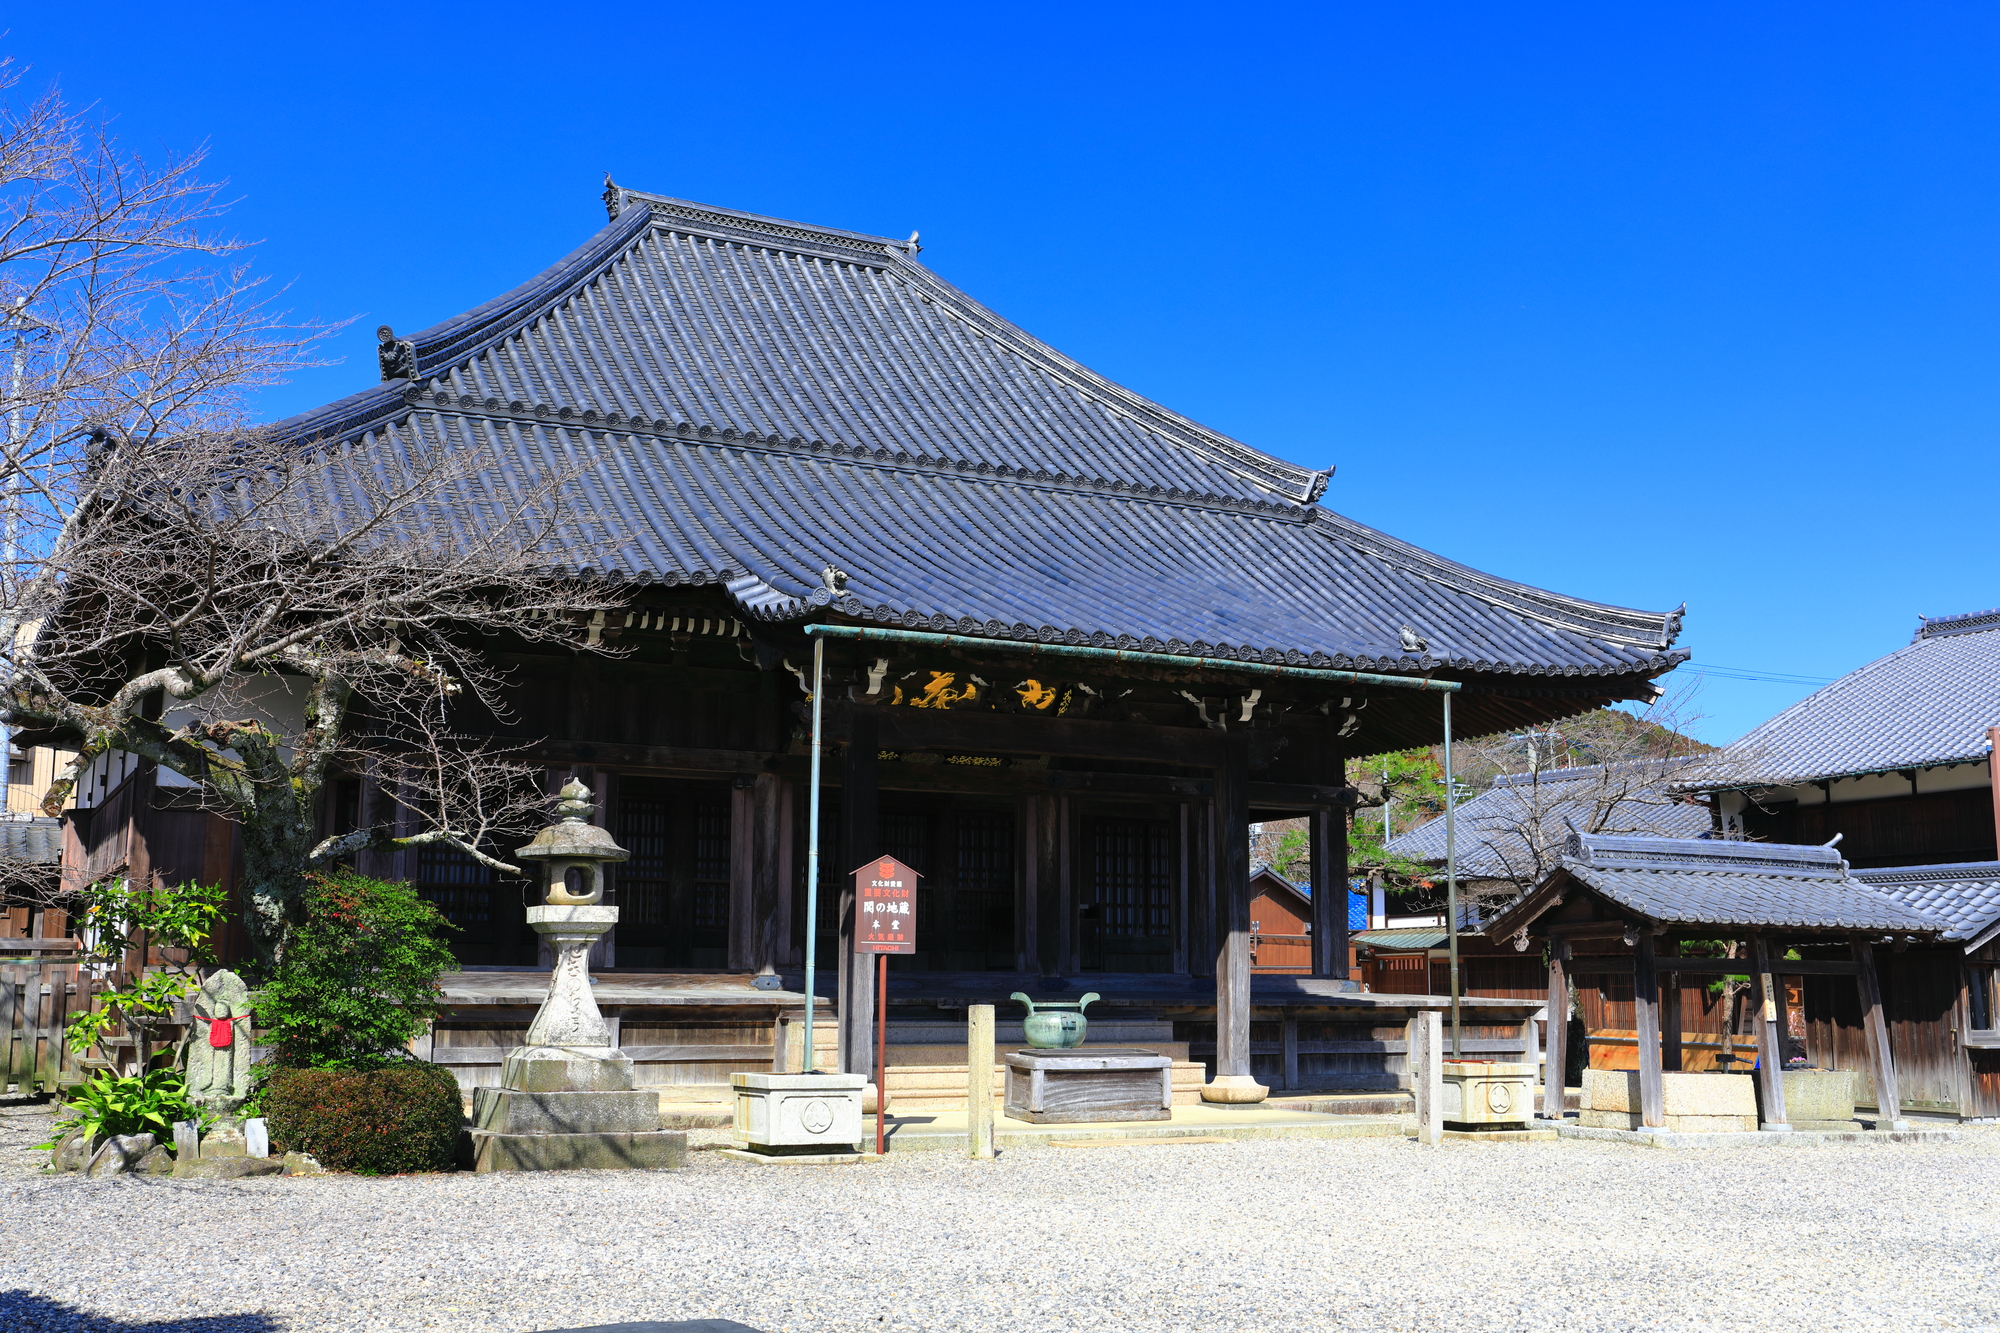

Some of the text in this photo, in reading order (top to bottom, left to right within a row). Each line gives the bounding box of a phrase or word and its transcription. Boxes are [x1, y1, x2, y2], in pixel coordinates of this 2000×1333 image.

[864, 888, 909, 897] 重要文化財
[864, 901, 910, 914] 関の地蔵
